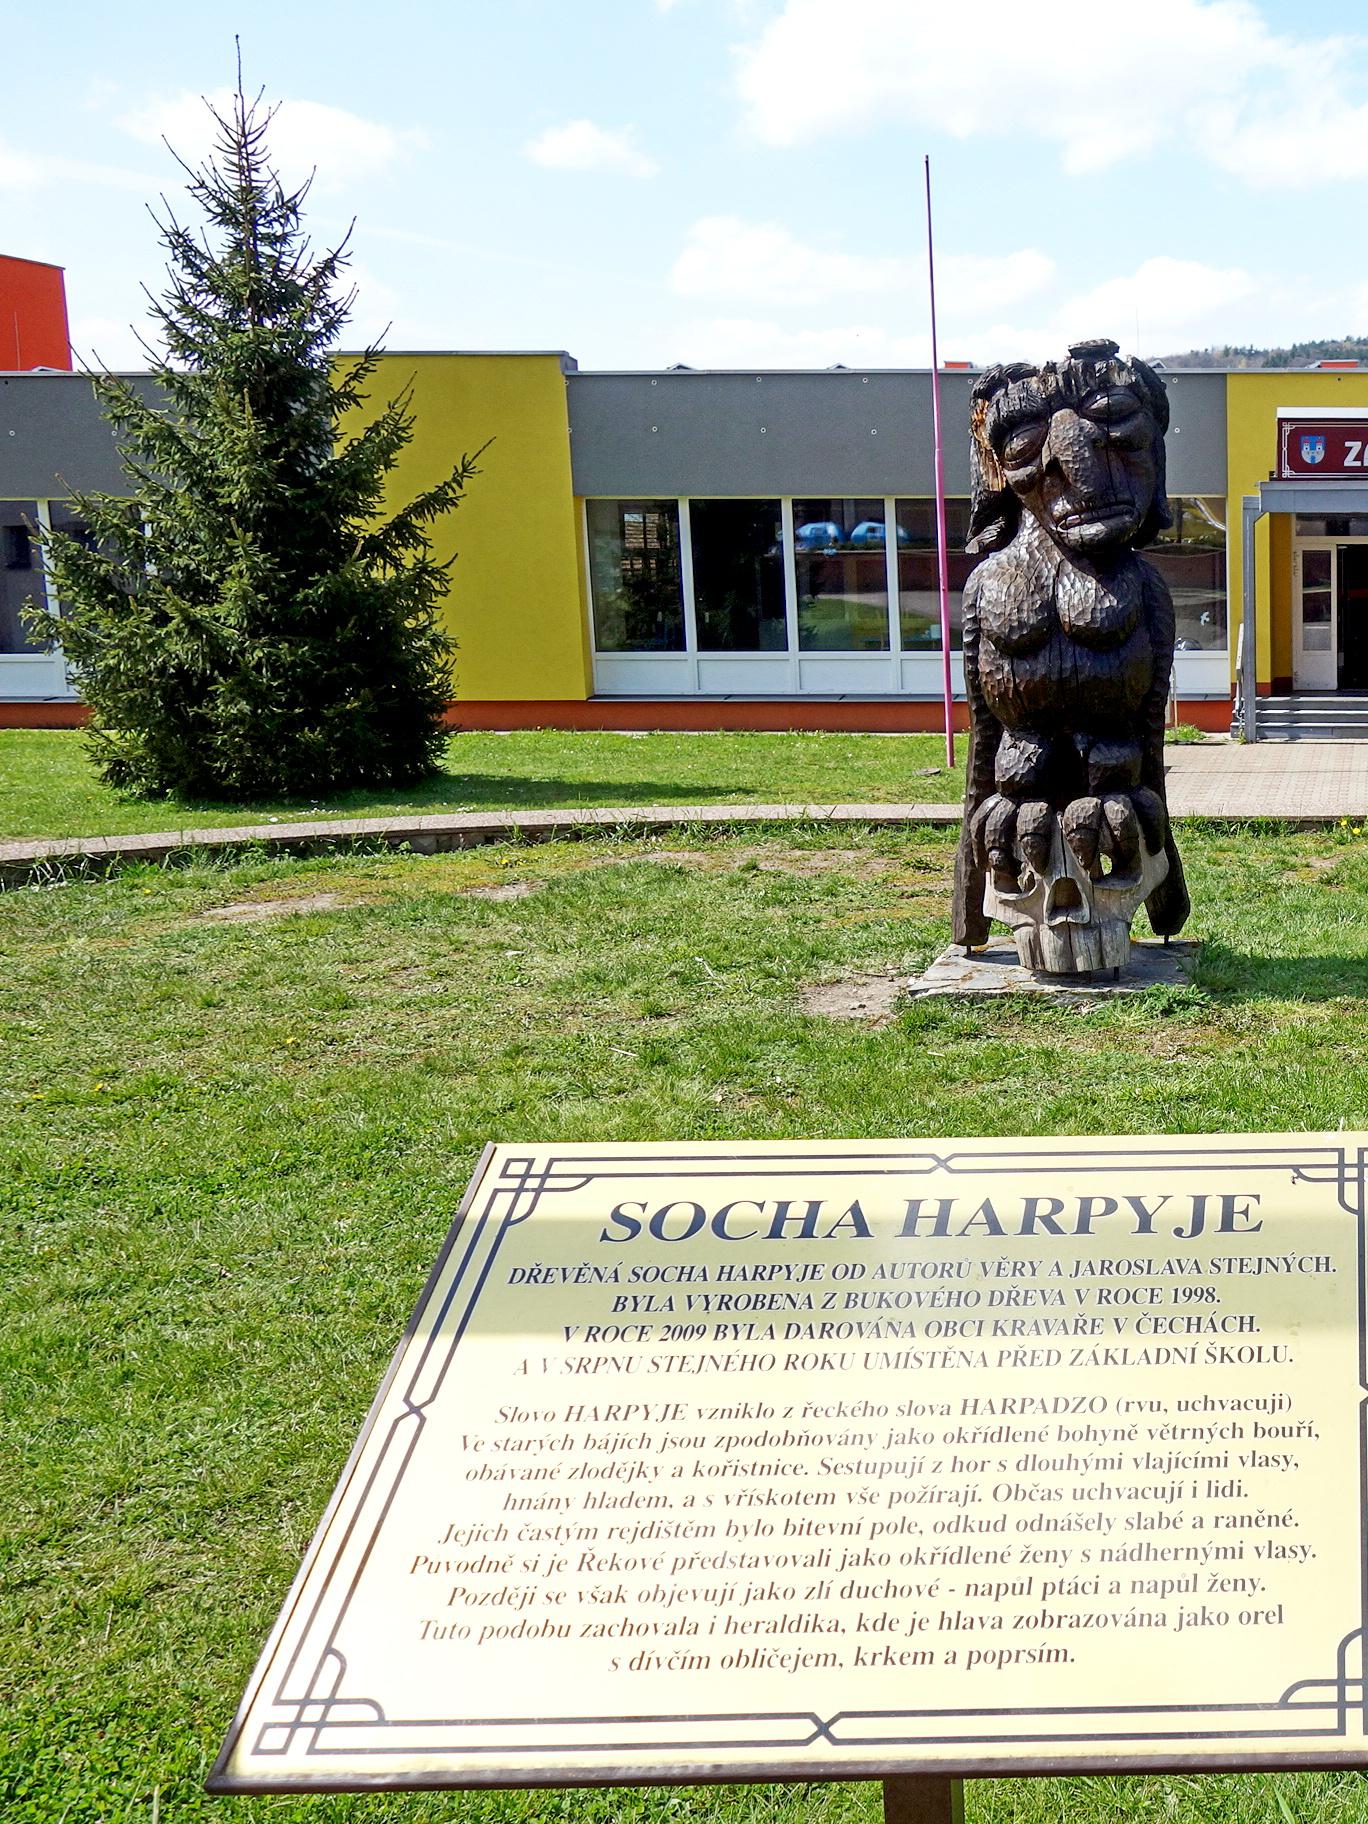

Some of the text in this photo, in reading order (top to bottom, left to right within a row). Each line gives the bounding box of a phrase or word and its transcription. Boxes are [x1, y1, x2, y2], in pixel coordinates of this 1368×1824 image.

[598, 1193, 1264, 1243] SOCHA HARPYJE
[506, 1251, 1337, 1286] DŘEVĚNÁ SOCHA HARPYJE OD AUTORŮ VĚRY A JAROSLAVA STEJNÝCH.
[610, 1283, 1222, 1314] BYLA VYROBENA Z BUKOVÉHO DŘEVA V ROCE 1998.
[563, 1310, 1261, 1344] V ROCE 2009 BYLA DAROVÁNA OBCI KRAVAŘE V ČECHÁCH.
[511, 1340, 1294, 1376] A V SRPNU STEJNÉHO ROKU UMÍSTĚNA PŘED ZÁKLADNÍ ŠKOLU.
[493, 1392, 1293, 1425] Slovo HARPYJE vzniklo z řeckého slova HARPADZO (rvu, uchvacuji)
[461, 1419, 1321, 1457] Ve starých bájích jsou zpodobňovány jako okřídlené bohyně větrných bouří,
[464, 1449, 1300, 1485] obávané zlodějky a kořistnice. Sestupují z hor s dlouhými vlajícími vlasy,
[501, 1478, 1249, 1516] hnány hladem, a s vřískotem vše požírají. Občas uchvacují i lidi.
[436, 1507, 1300, 1549] Jejich častým rejdištěm bylo bitevní pole, odkud odnášely slabé a raněné.
[521, 1552, 542, 1574] si
[540, 1552, 569, 1579] je
[575, 1546, 667, 1573] Řekové
[669, 1547, 833, 1577] představovali
[834, 1546, 892, 1574] jako
[898, 1543, 1013, 1567] okřídlené
[1018, 1543, 1073, 1569] ženy
[1079, 1547, 1092, 1564] s
[1099, 1539, 1245, 1567] nádhernými
[1253, 1539, 1317, 1565] vlasy.
[446, 1584, 539, 1612] Později
[541, 1590, 568, 1606] se
[577, 1583, 629, 1605] však
[636, 1581, 739, 1609] objevují
[738, 1580, 797, 1608] jako
[802, 1578, 835, 1601] zlí
[838, 1577, 942, 1601] duchové
[963, 1575, 1034, 1604] napůl
[1039, 1573, 1101, 1602] ptáci
[1107, 1580, 1122, 1595] a
[1129, 1572, 1199, 1600] napůl
[1205, 1571, 1266, 1599] ženy.
[419, 1603, 1285, 1647] Tuto podobu zachovala i heraldika, kde je hlava zobrazována jako orel
[610, 1641, 1076, 1675] s dívčím obličejem, krkem a poprsím.
